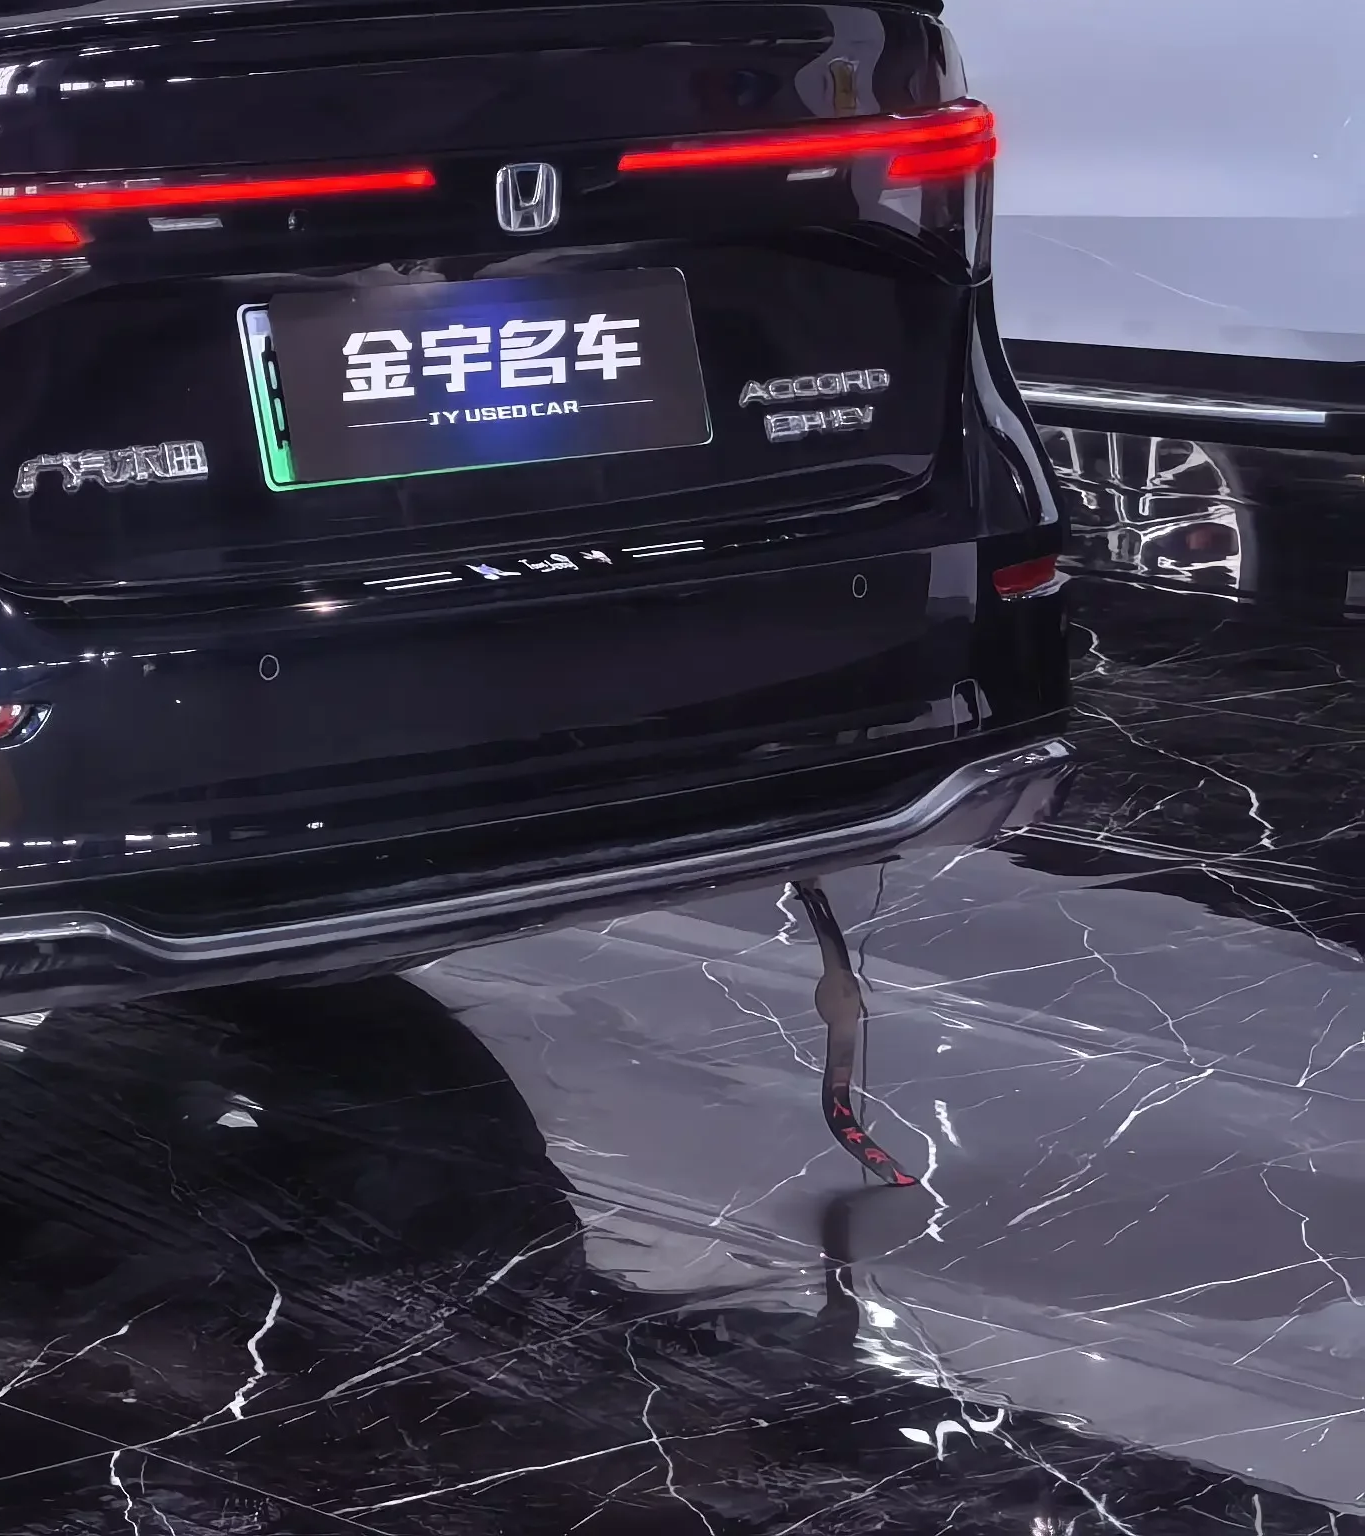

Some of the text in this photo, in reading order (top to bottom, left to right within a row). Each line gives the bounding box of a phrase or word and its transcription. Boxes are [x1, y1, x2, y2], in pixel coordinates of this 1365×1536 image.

[342, 313, 642, 402] 金宇名车
[739, 368, 891, 408] ACCORD
[428, 400, 580, 426] JY USED CAR
